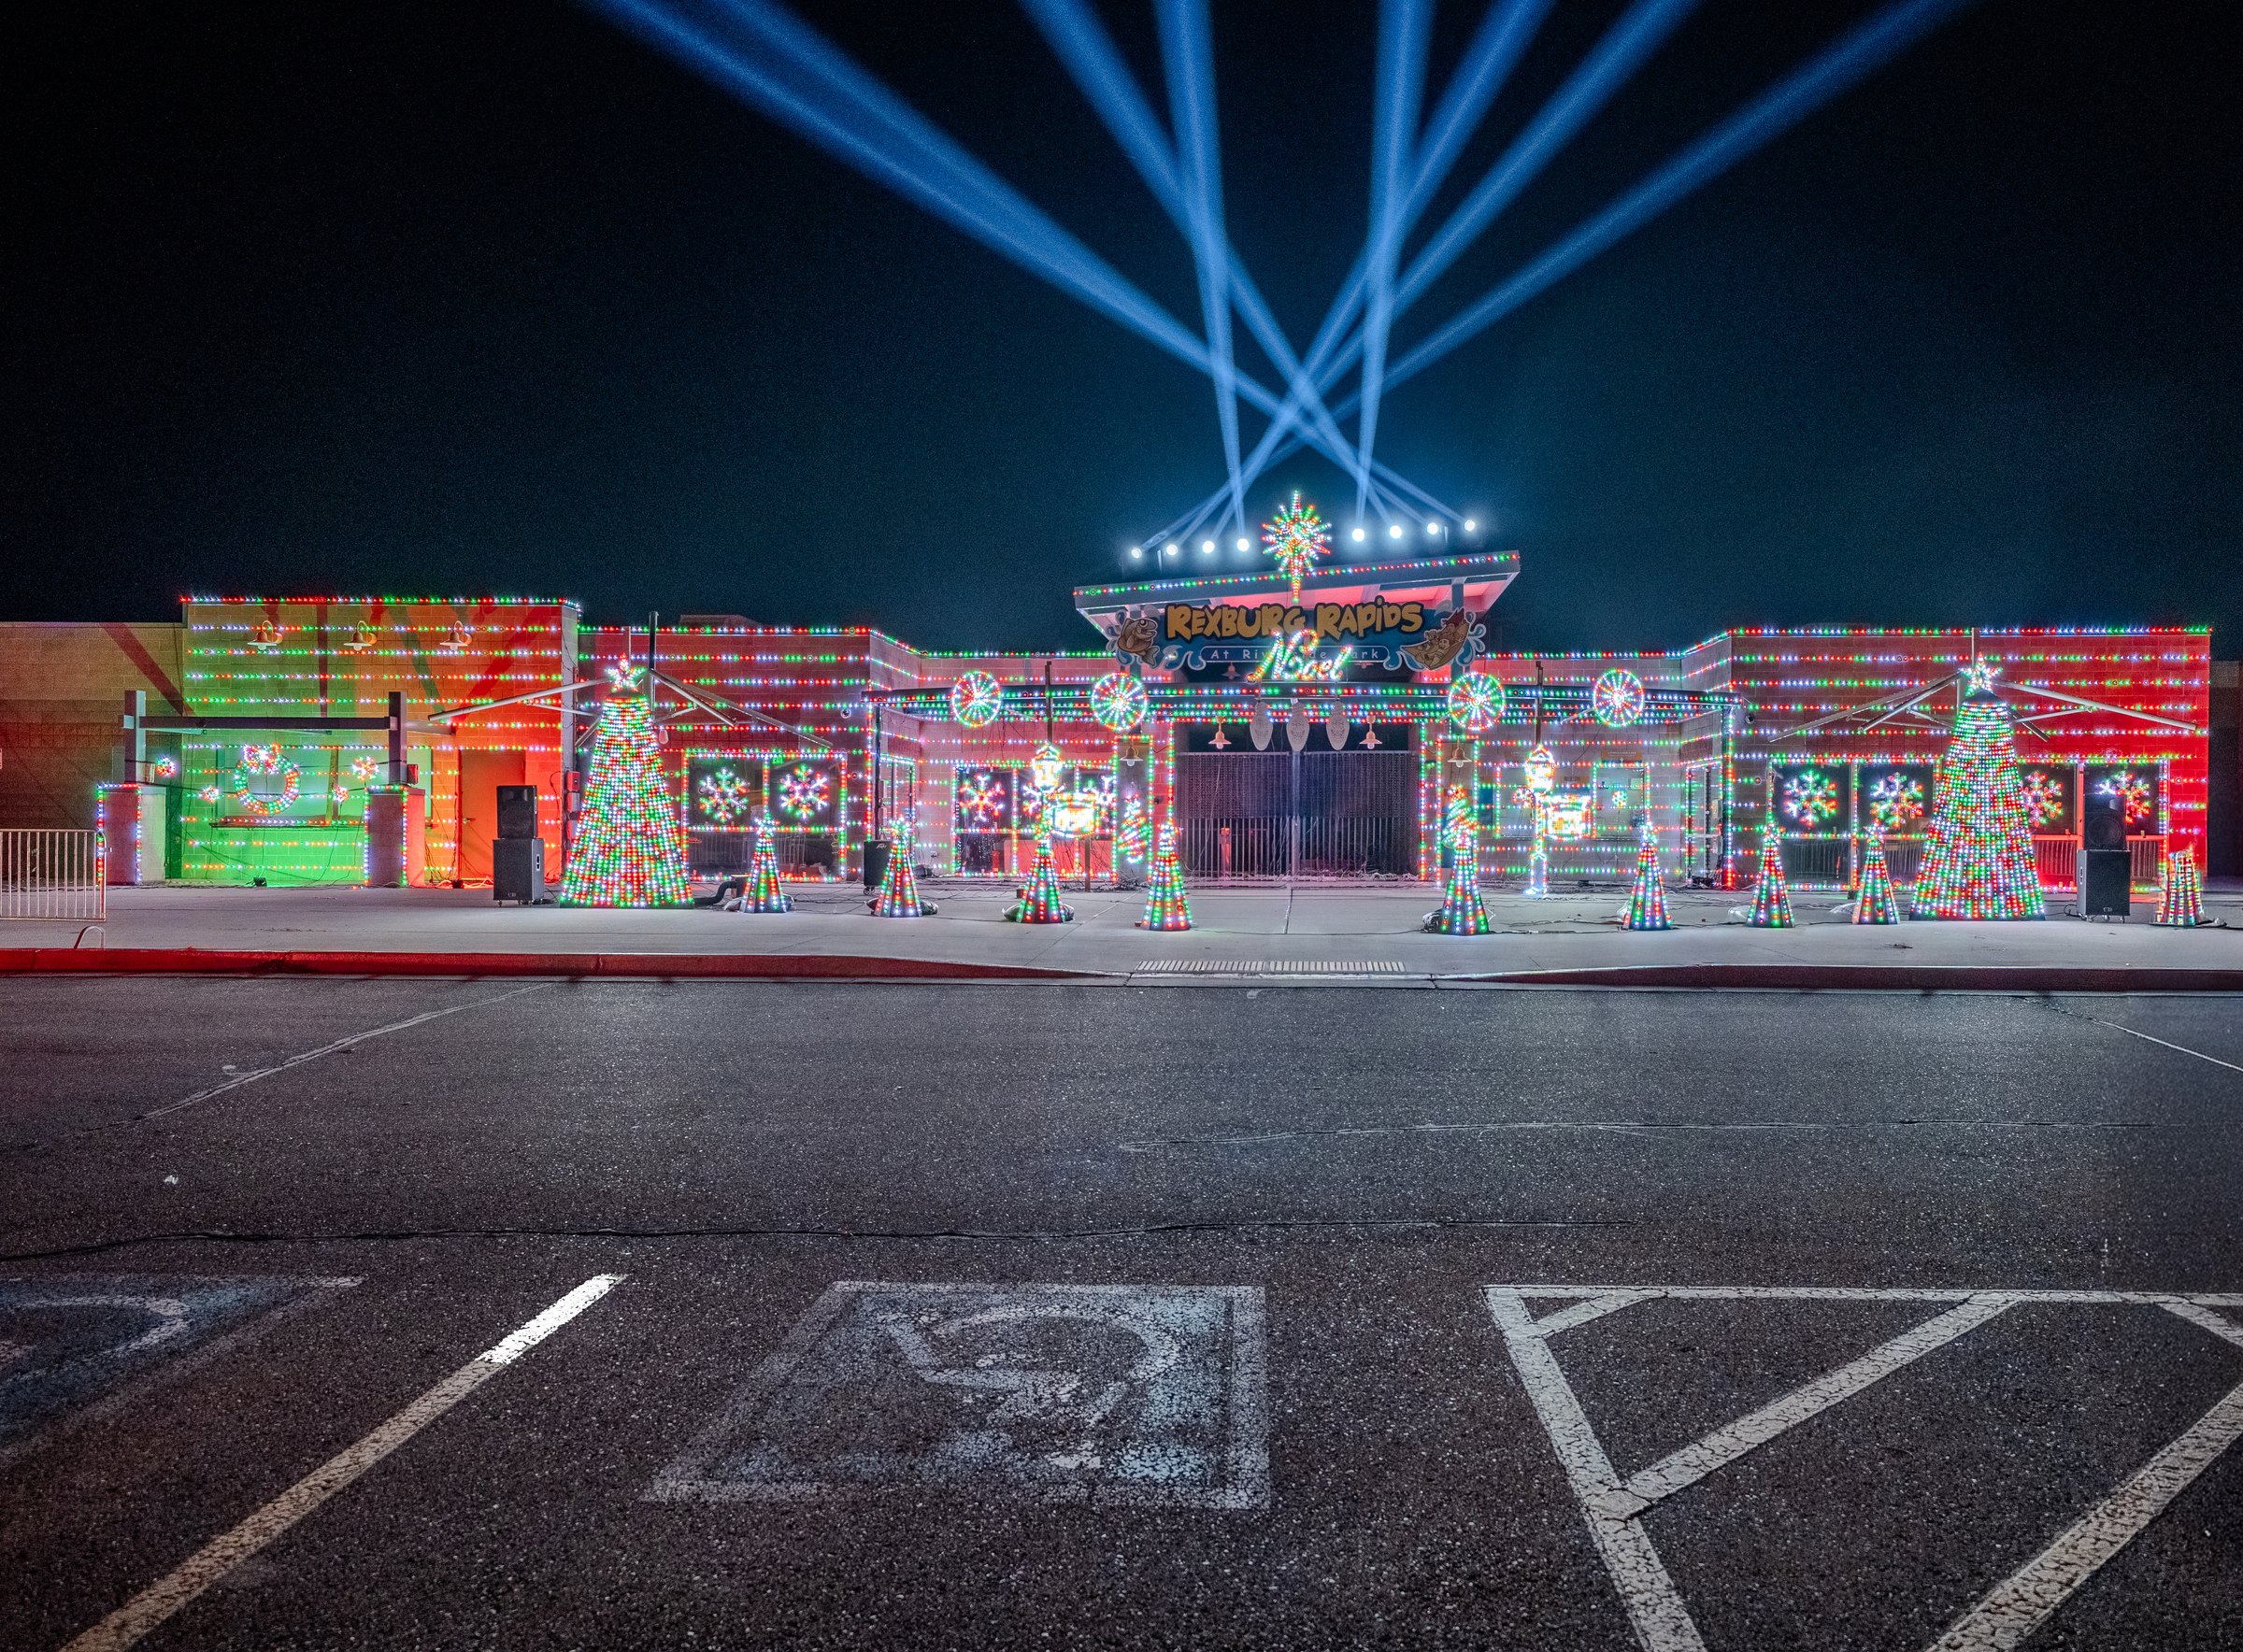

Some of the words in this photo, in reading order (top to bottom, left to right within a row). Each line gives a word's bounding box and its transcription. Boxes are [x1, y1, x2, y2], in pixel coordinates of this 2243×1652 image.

[1167, 603, 1307, 643] REXBURG
[1210, 649, 1230, 660] At
[1242, 648, 1327, 660] Rivside
[1343, 648, 1379, 660] ark
